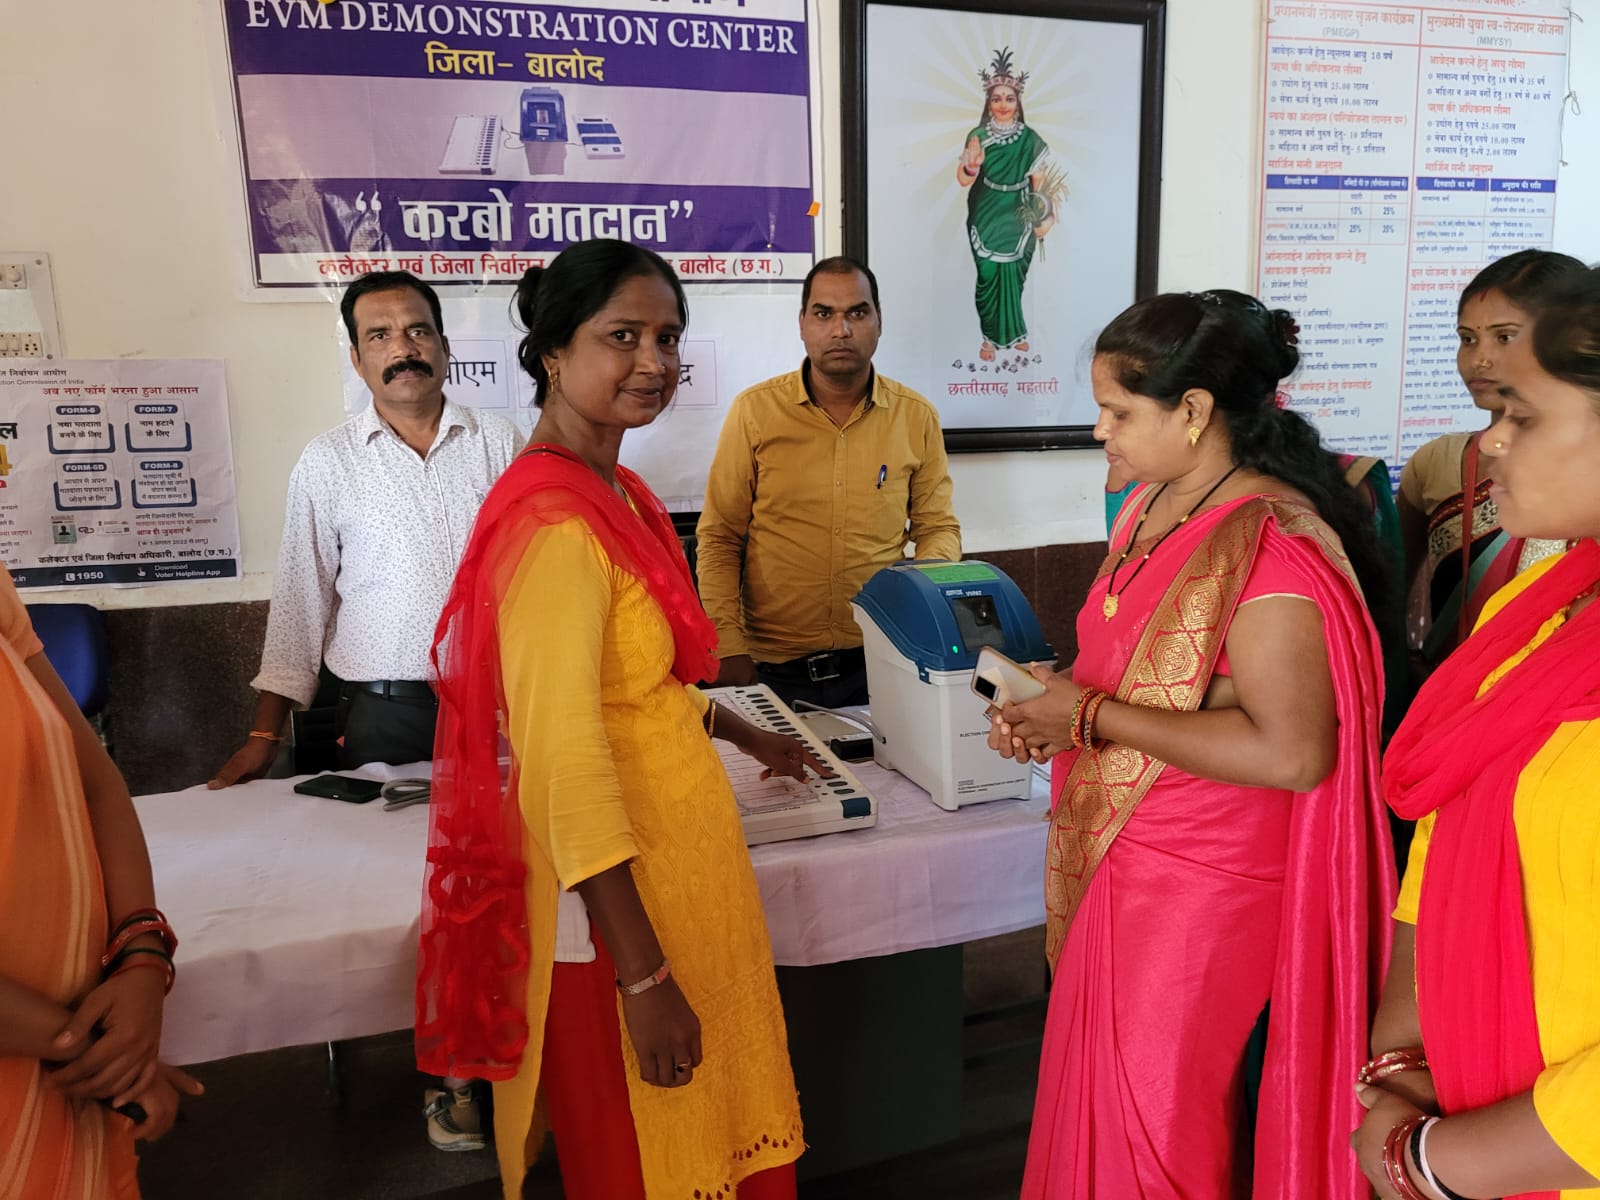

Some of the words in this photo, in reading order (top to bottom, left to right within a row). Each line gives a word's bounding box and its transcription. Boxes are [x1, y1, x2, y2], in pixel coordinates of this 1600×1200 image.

[246, 0, 332, 30] EVM
[341, 1, 658, 46] DEMONSTRATION
[667, 19, 798, 54] CENTER
[1427, 14, 1466, 32] मुख्यमंत्री
[1537, 20, 1564, 36] योजना
[1322, 27, 1360, 39] (PMEGP)
[1477, 37, 1512, 48] (MMYSY)
[525, 48, 605, 81] बालोद
[398, 188, 513, 242] करबो
[398, 254, 424, 275] एवं
[430, 253, 474, 275] जिला
[679, 254, 726, 274] बालोद
[9, 368, 39, 377] निर्वाचन
[42, 368, 67, 377] आयोग
[42, 387, 60, 396] अब
[64, 387, 80, 396] नए
[83, 384, 106, 396] फॉर्म
[110, 386, 138, 395] भरना
[142, 386, 162, 398] हुआ
[166, 386, 199, 395] आसान
[947, 378, 1008, 398] छत्तीसगढ़
[1016, 377, 1060, 396] महतारी
[156, 429, 170, 438] लिए
[38, 553, 69, 565] कलेक्टर
[72, 552, 84, 563] एवं
[86, 553, 104, 563] जिला
[106, 551, 137, 561] निर्वाचन
[77, 571, 104, 580] 1950
[155, 570, 174, 579] Voter
[175, 570, 205, 578] Helpline
[206, 569, 221, 578] App
